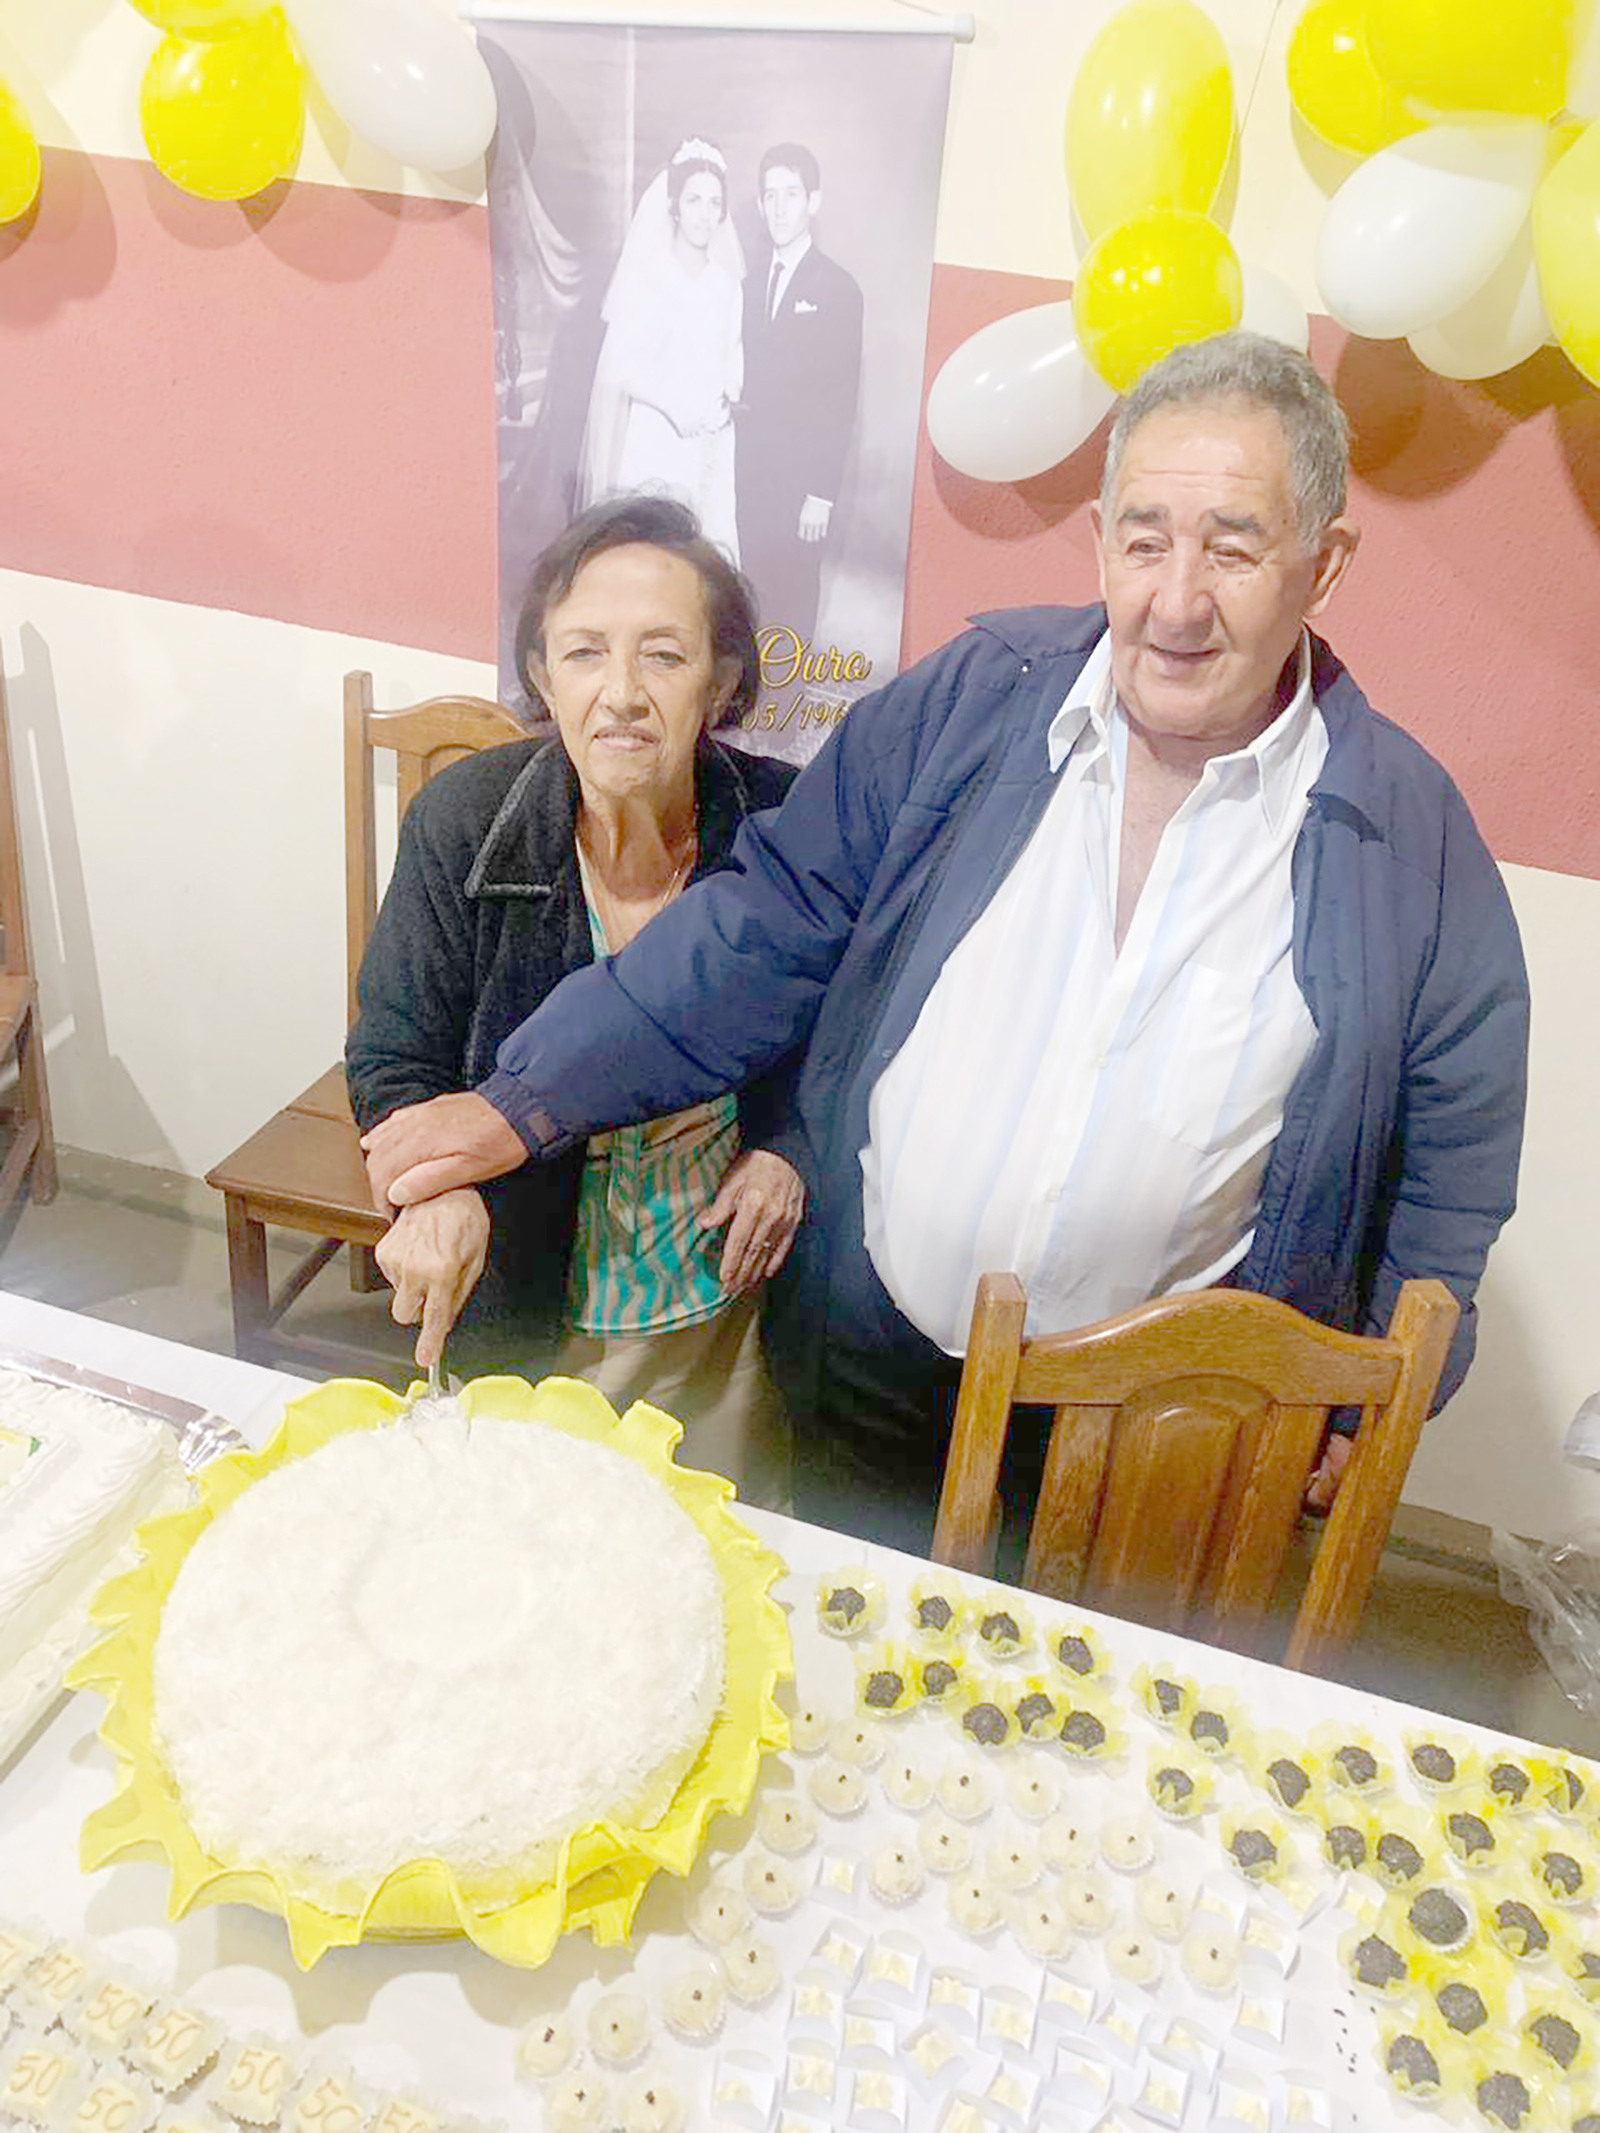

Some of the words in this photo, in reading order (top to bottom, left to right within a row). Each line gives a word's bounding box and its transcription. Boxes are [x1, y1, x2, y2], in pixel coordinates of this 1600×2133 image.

[755, 625, 872, 688] Ouro
[85, 1983, 139, 2031] 50
[145, 2010, 203, 2063] 50
[9, 2055, 62, 2097] 50
[230, 2050, 282, 2095] 50
[77, 2087, 135, 2131] 50
